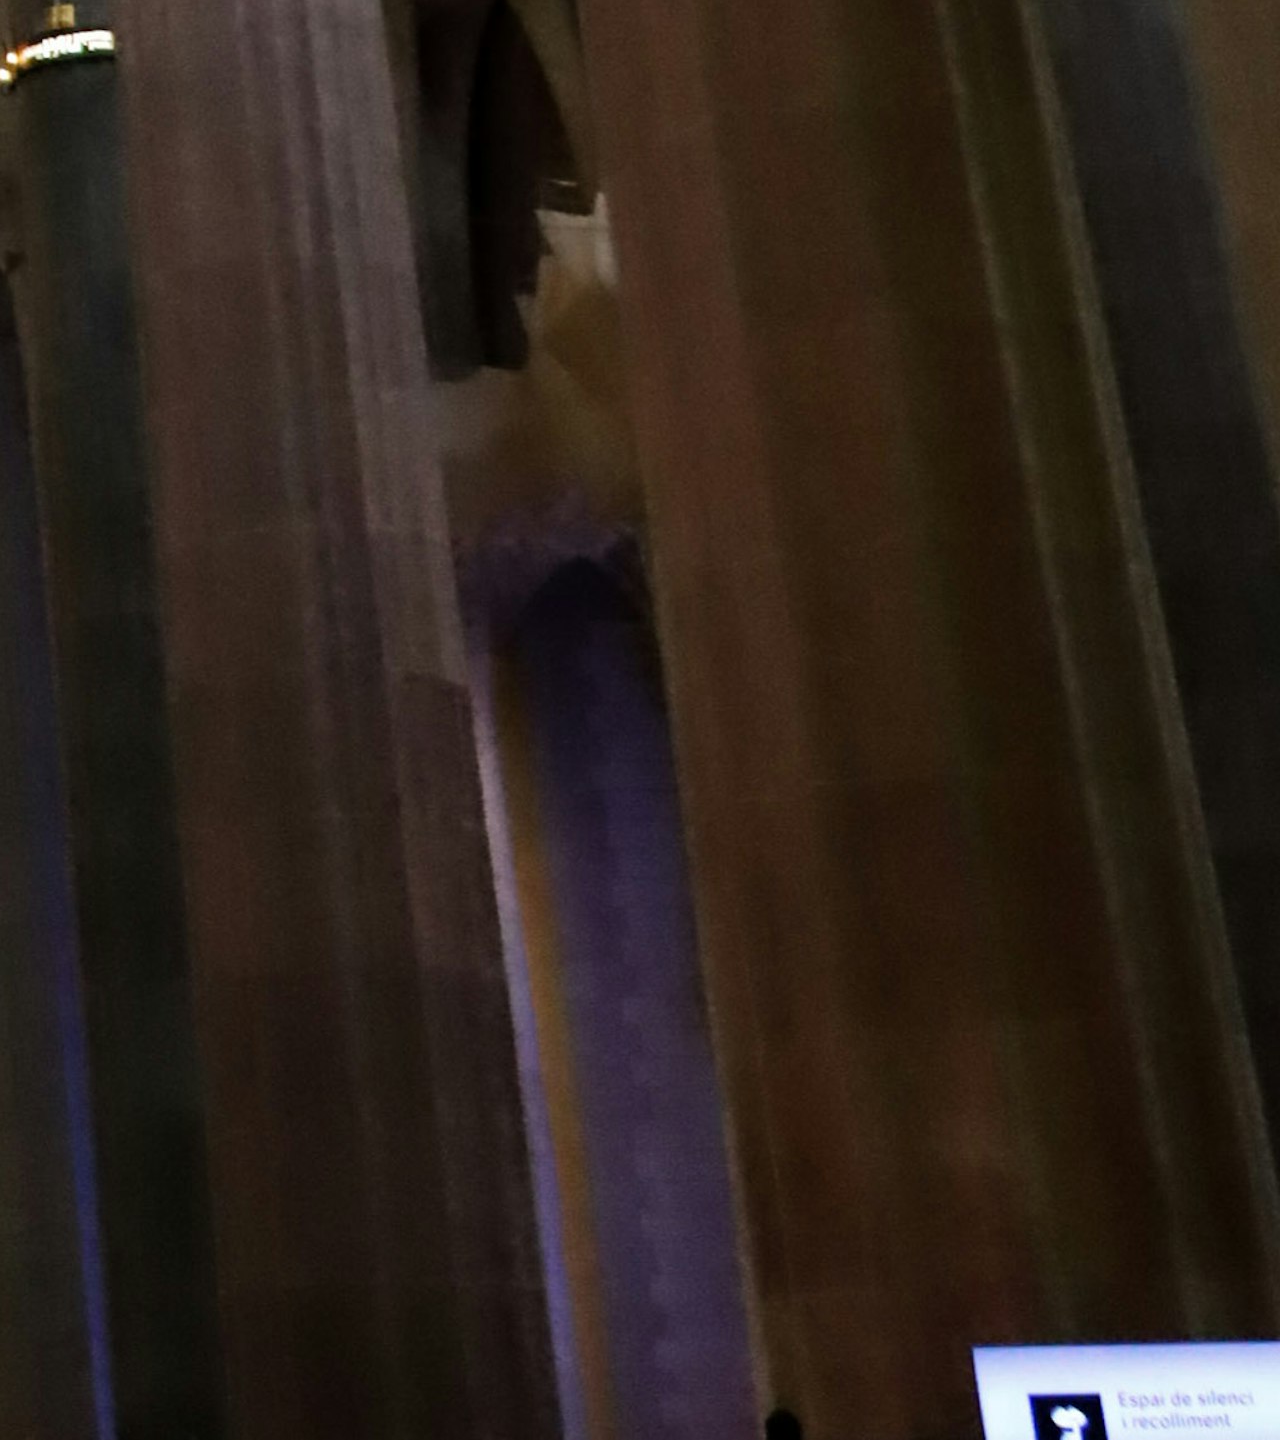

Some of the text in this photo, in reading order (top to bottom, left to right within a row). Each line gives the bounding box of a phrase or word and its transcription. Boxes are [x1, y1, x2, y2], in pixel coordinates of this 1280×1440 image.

[1117, 1387, 1254, 1410] Espai de silenci
[1131, 1412, 1232, 1430] recolliment
